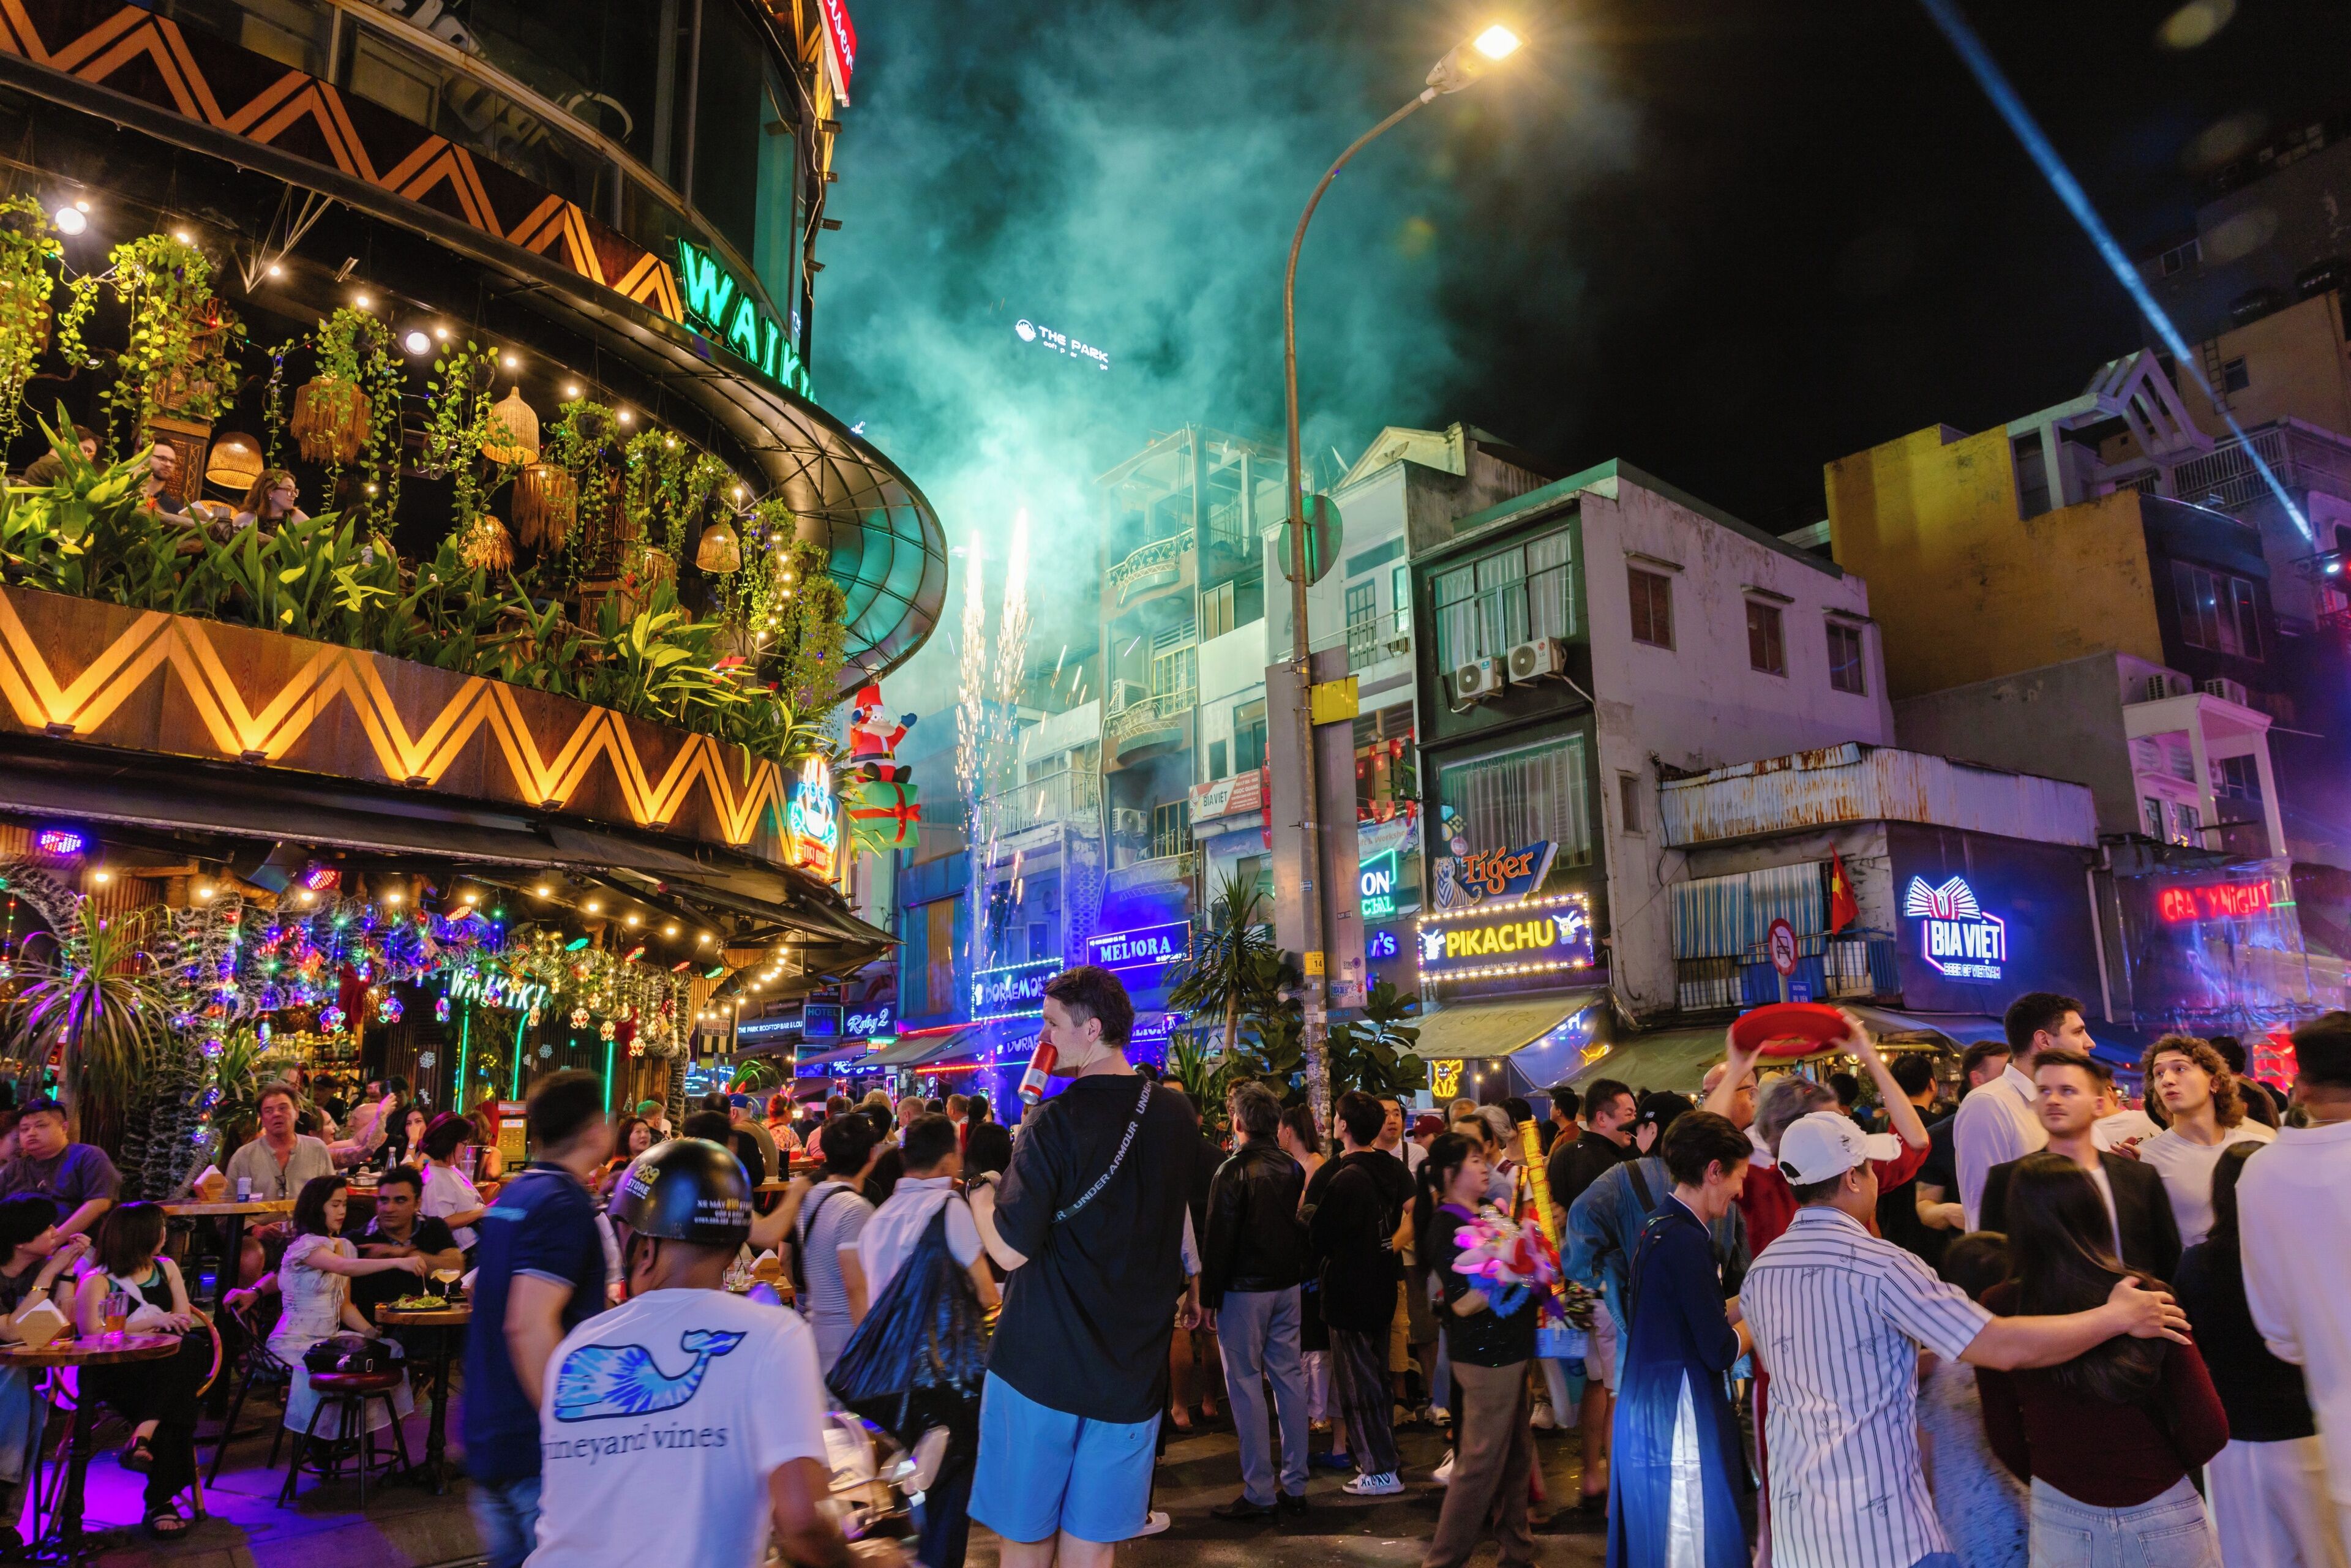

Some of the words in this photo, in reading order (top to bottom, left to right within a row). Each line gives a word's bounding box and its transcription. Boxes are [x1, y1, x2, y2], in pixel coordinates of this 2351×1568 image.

[1038, 325, 1067, 346] THE
[1071, 339, 1109, 364] PARK
[1204, 795, 1213, 807] BIA
[1213, 790, 1228, 805] VIỆT
[803, 844, 815, 861] TIKI
[1361, 871, 1390, 896] ON
[1463, 846, 1534, 895] Tiger
[2163, 889, 2218, 920] CRAY
[1100, 936, 1171, 962] MELIORA
[1446, 919, 1554, 958] PIKACHU
[1930, 920, 1963, 956] BIA
[1963, 920, 2000, 965] VIỆT
[1944, 962, 1962, 976] BEER
[1963, 964, 1972, 977] OF
[1972, 964, 2001, 979] VIETNAM
[808, 1008, 838, 1016] HOTEL
[847, 1014, 878, 1034] Ruby
[877, 1008, 888, 1027] 2
[1073, 1172, 1110, 1210] UNDER
[1109, 1120, 1139, 1174] ARMOUR
[626, 1178, 650, 1196] STORE
[651, 1421, 729, 1448] vines
